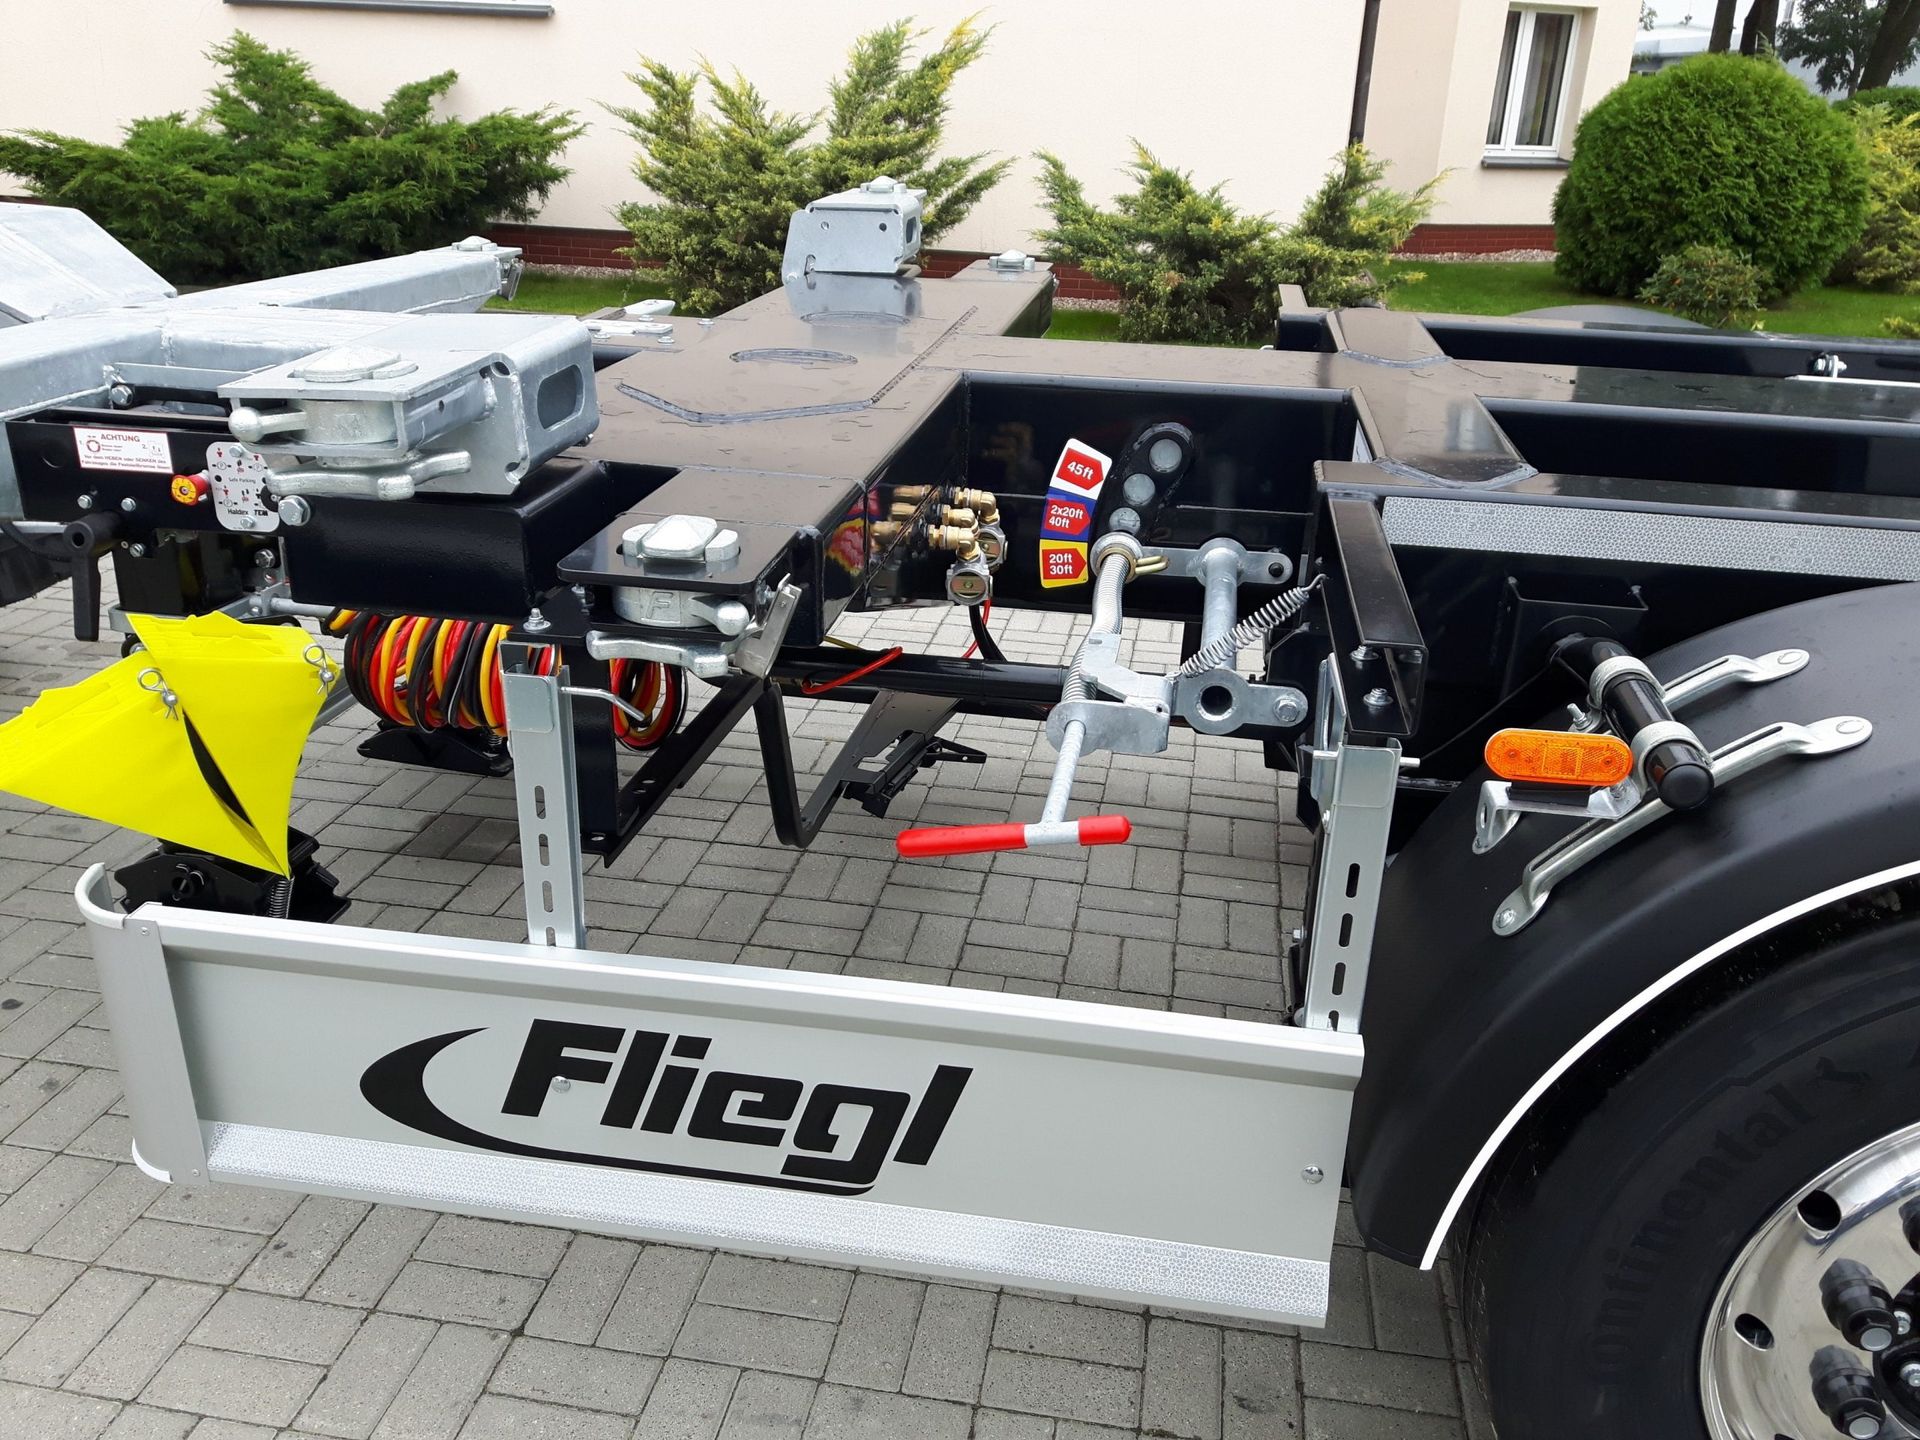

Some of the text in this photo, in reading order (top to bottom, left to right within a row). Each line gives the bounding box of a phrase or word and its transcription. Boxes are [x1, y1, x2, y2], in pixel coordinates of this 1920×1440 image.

[100, 433, 140, 443] ACHTUNG
[1067, 461, 1094, 480] 45ft
[1050, 504, 1084, 520] 2x20ft
[1049, 516, 1070, 529] 40ft
[1049, 553, 1073, 564] 20ft
[1050, 564, 1073, 575] 30ft
[645, 590, 674, 619] F
[500, 1018, 974, 1185] Fliegl
